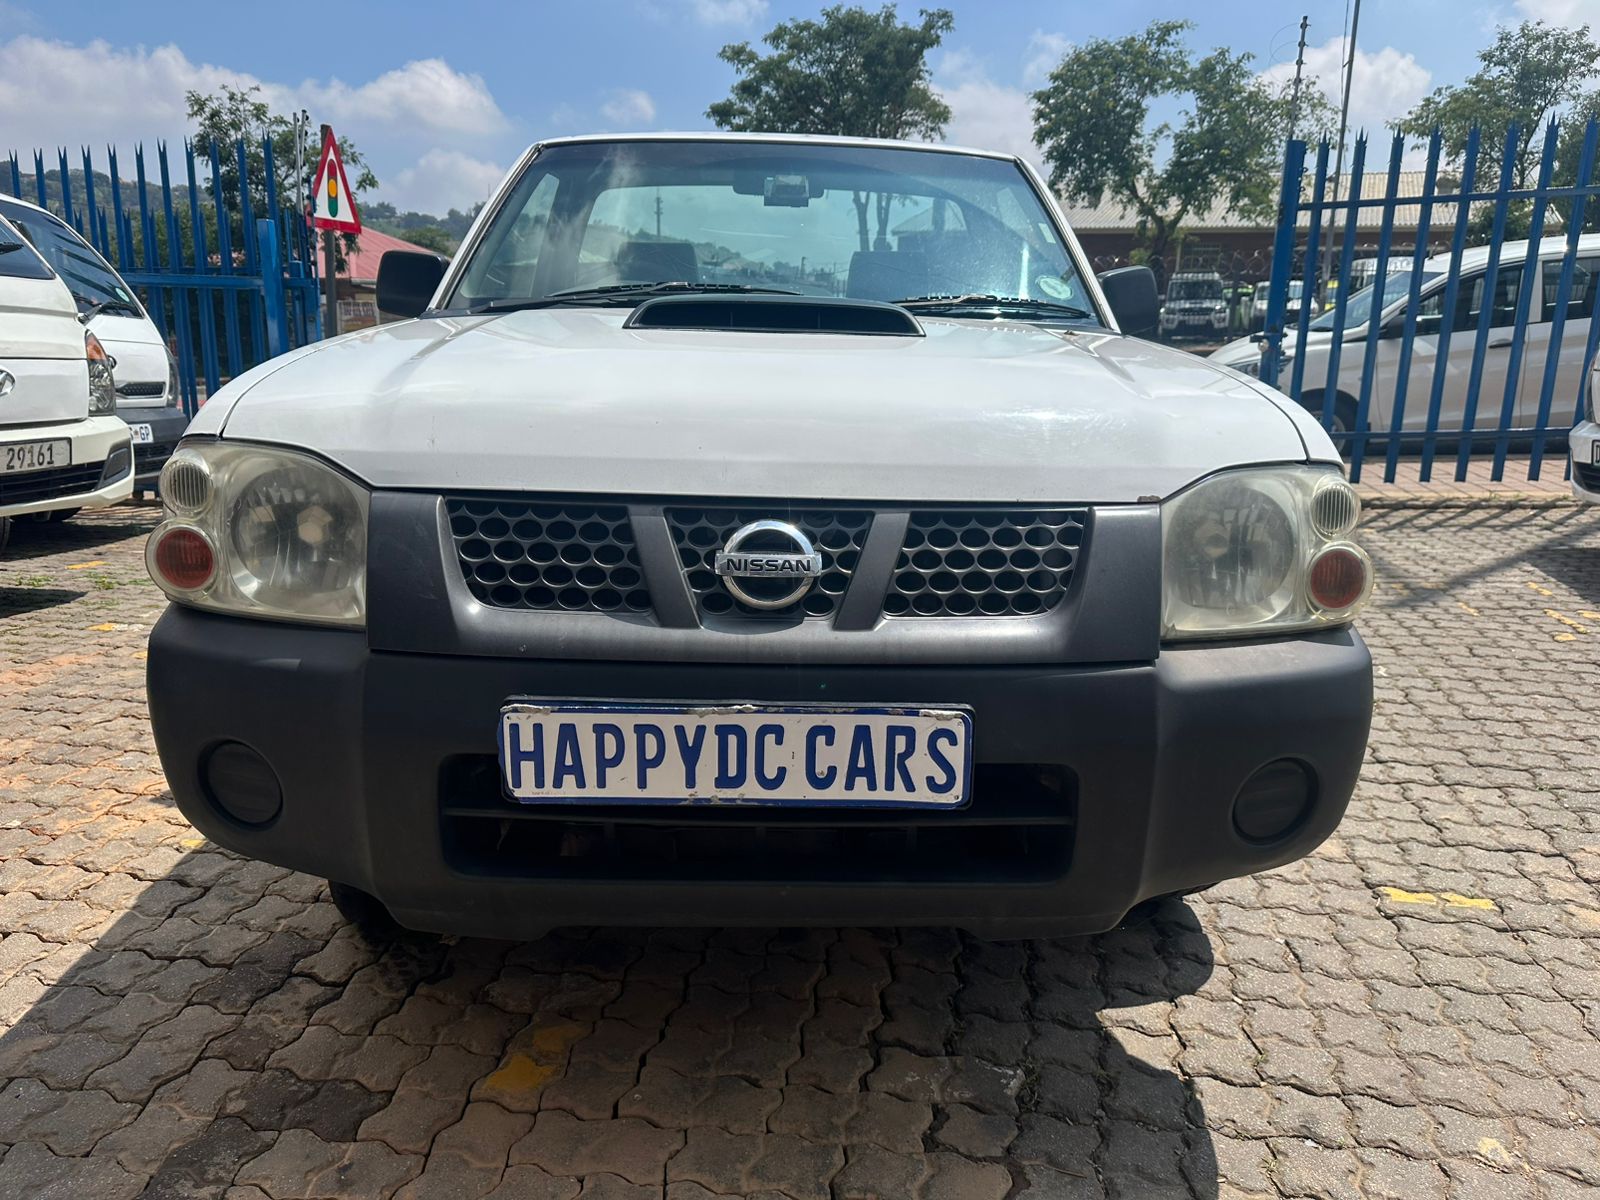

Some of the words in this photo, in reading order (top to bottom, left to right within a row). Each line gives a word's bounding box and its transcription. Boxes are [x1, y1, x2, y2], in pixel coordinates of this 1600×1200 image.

[139, 426, 149, 441] GP
[6, 443, 54, 470] 29161
[726, 558, 811, 572] NISSAN
[509, 722, 787, 791] HAPPYDC
[804, 724, 959, 794] CARS
